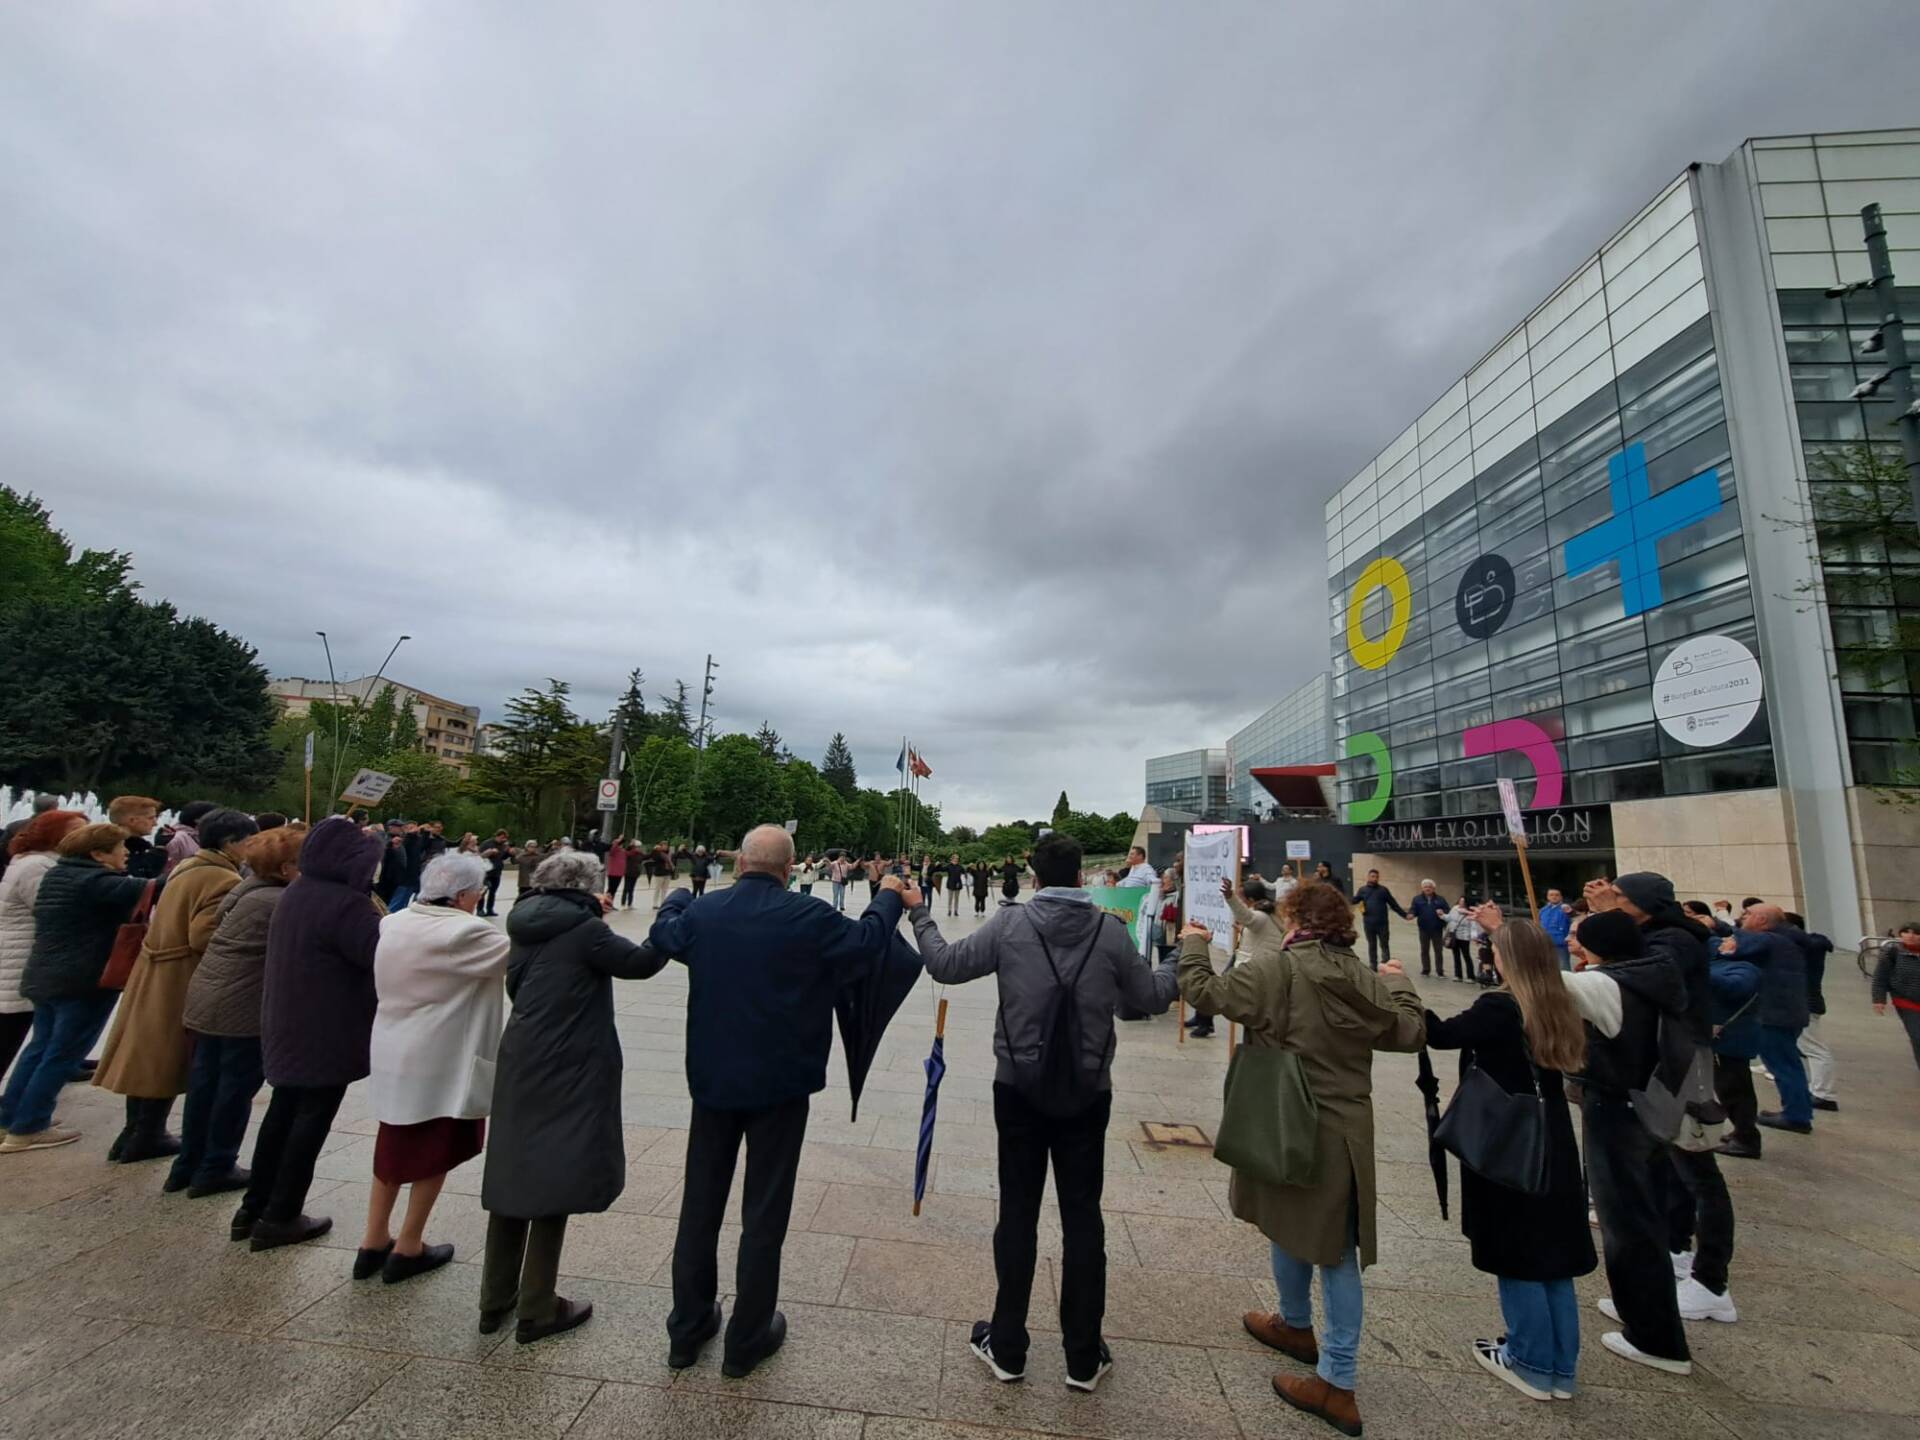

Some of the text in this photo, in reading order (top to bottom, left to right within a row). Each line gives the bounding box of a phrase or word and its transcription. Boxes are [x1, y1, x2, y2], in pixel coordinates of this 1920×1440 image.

[1366, 809, 1590, 841] FÓRUM EVOLUIÓN
[1508, 831, 1590, 845] DITORIO
